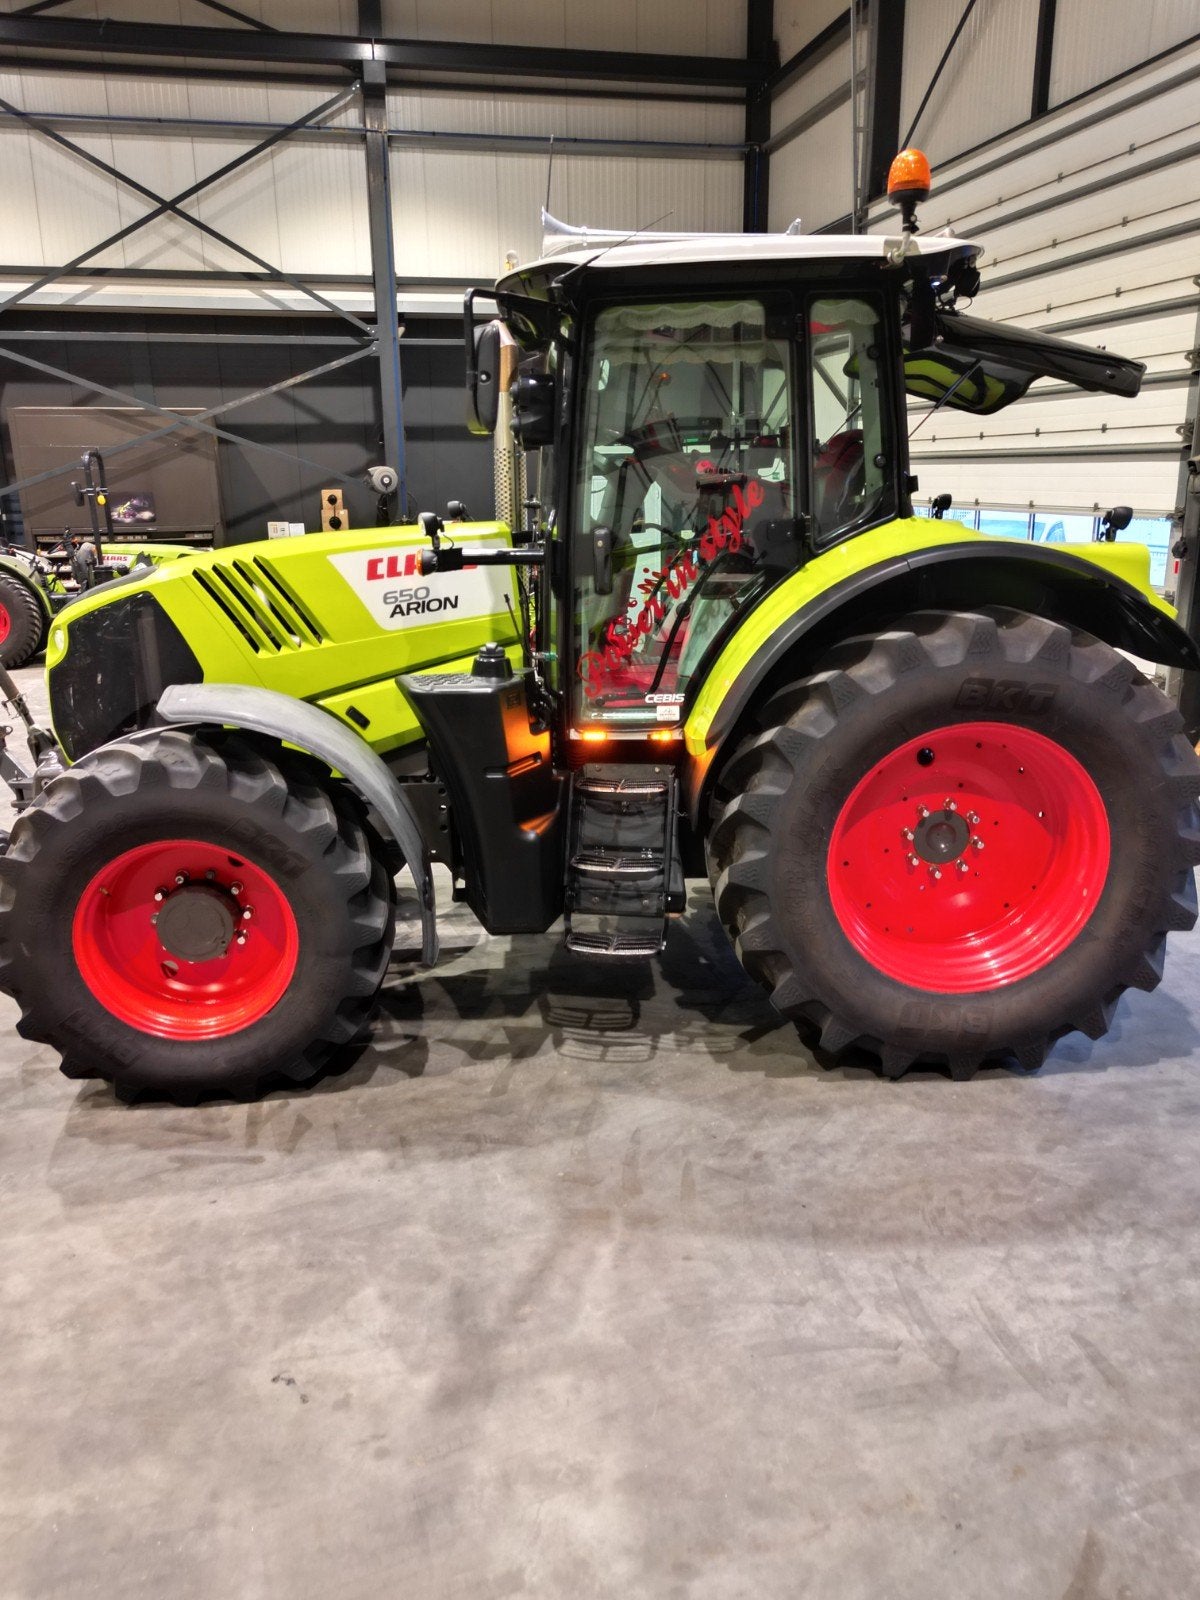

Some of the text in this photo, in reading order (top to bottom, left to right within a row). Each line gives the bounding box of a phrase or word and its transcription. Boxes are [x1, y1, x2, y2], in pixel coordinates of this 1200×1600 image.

[700, 480, 765, 561] style
[383, 586, 430, 605] 650
[390, 595, 459, 618] ARION
[645, 693, 685, 703] CEBIS
[955, 678, 1059, 716] BKT
